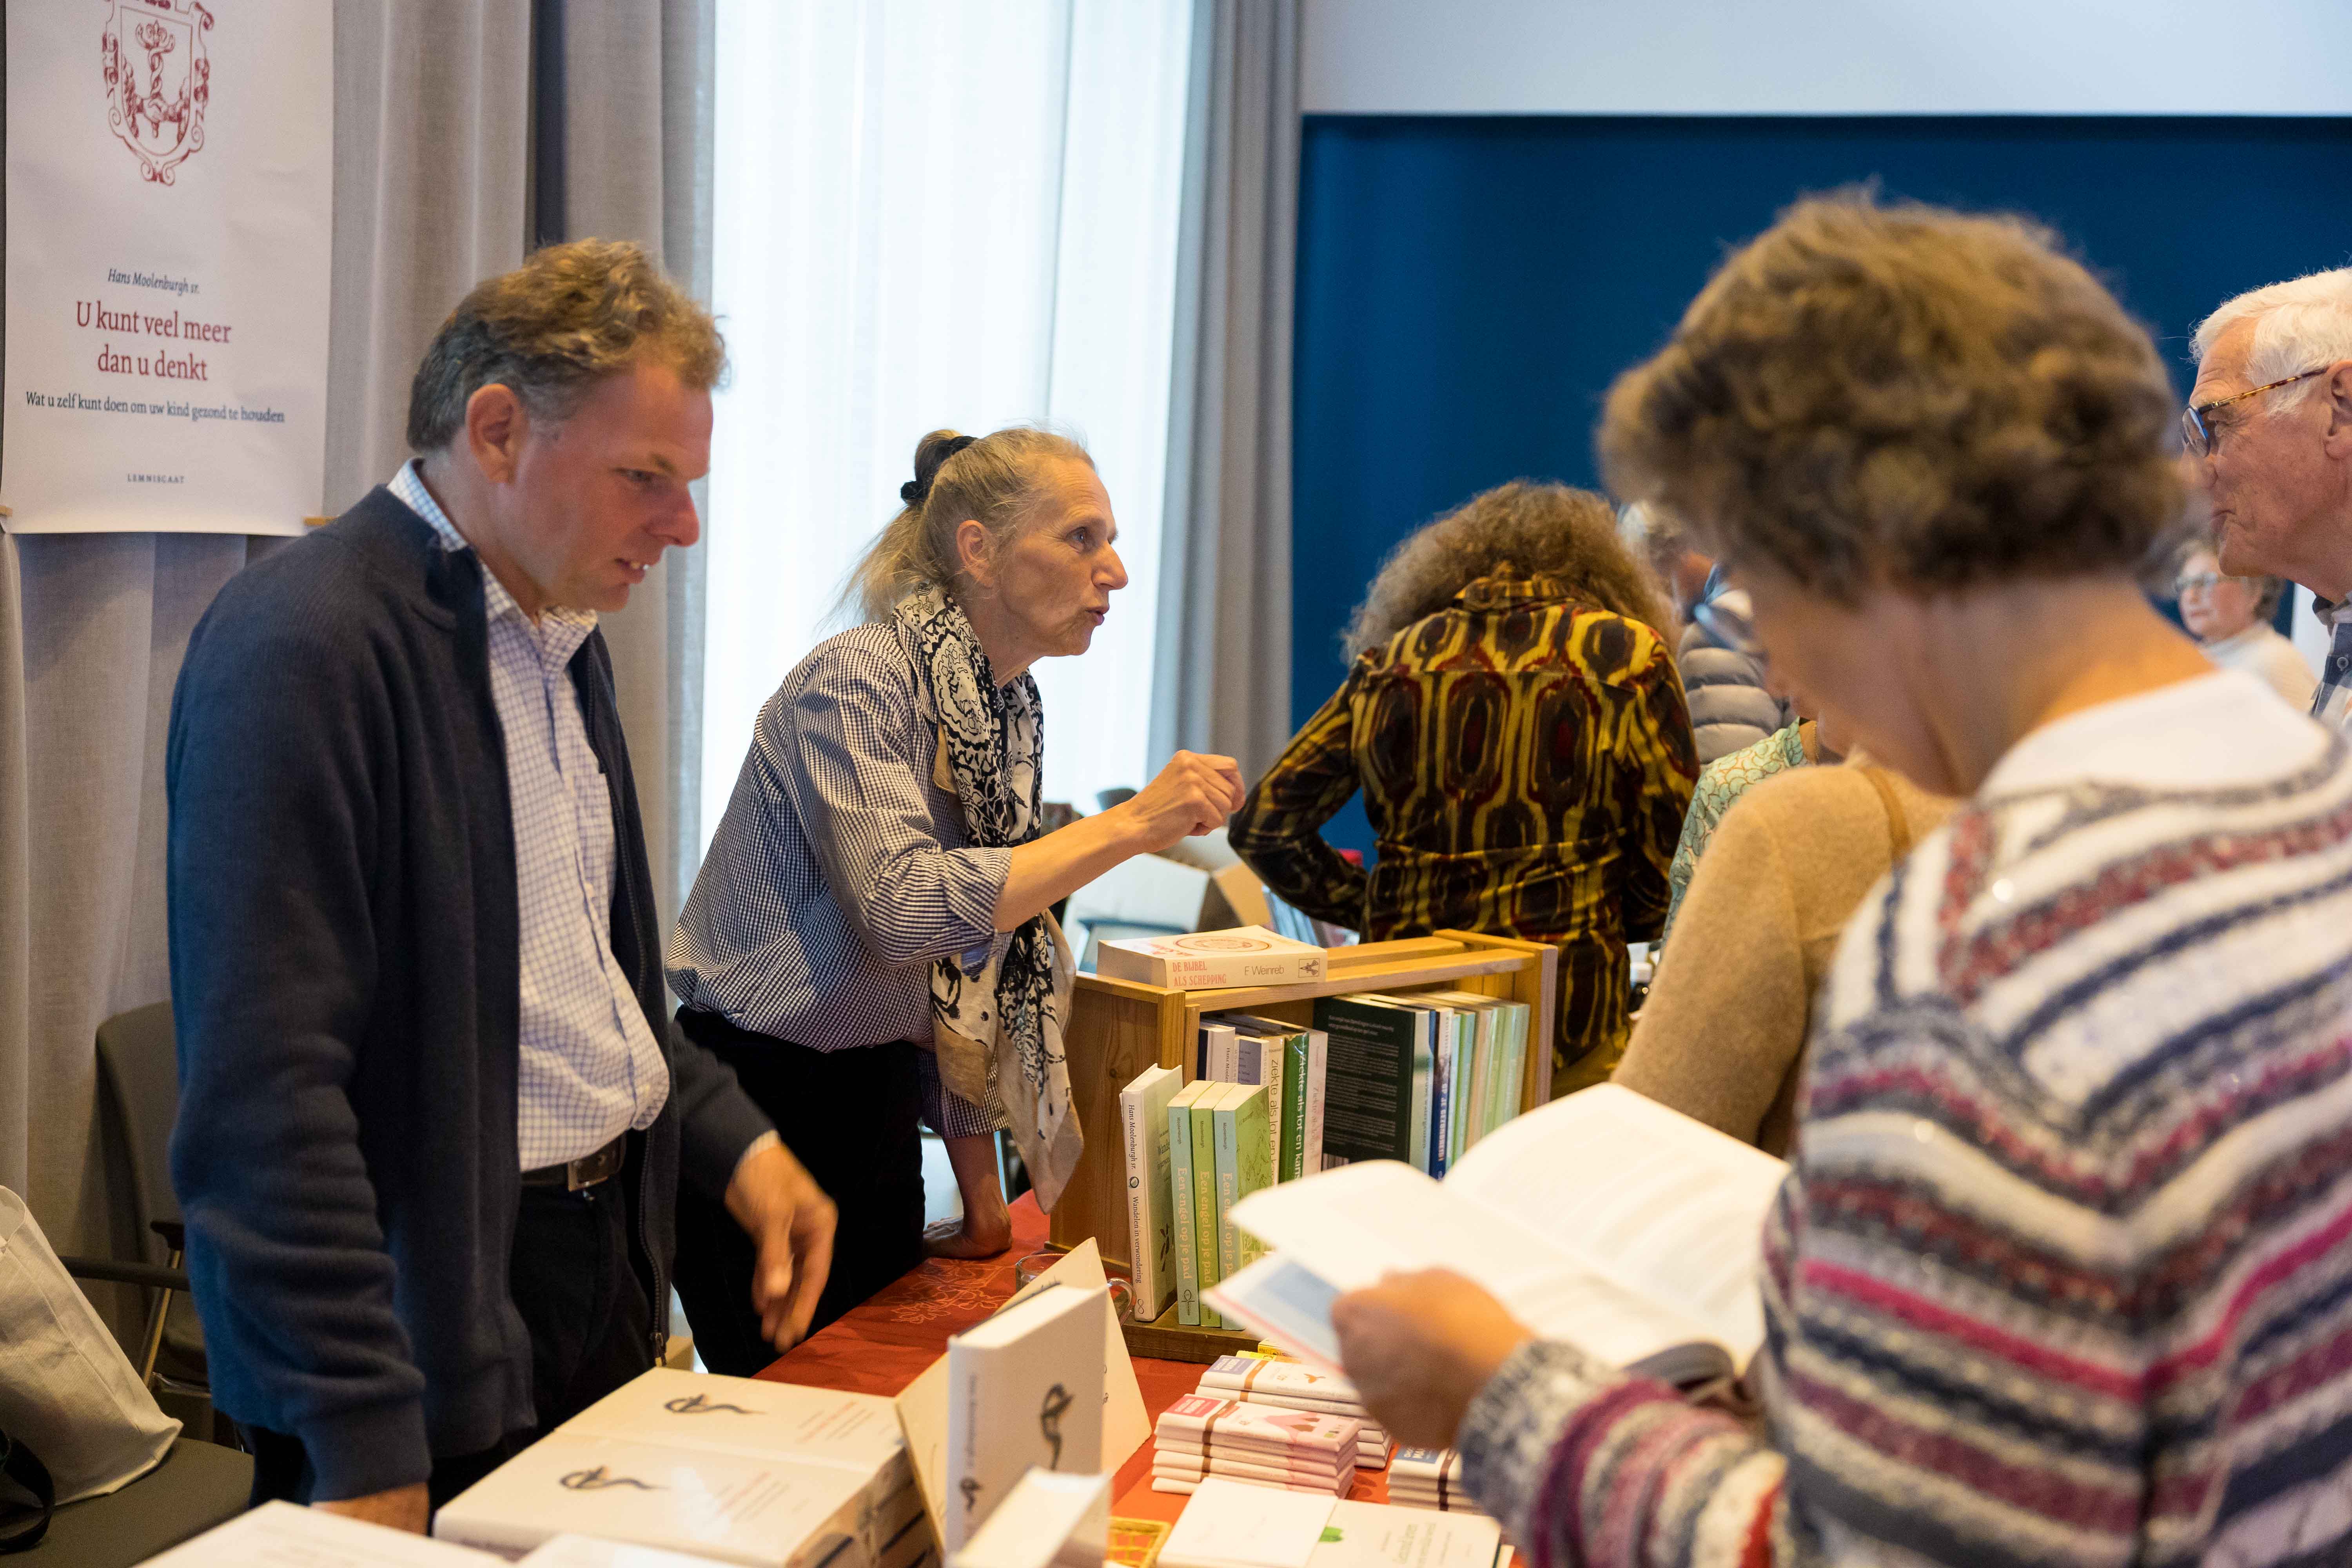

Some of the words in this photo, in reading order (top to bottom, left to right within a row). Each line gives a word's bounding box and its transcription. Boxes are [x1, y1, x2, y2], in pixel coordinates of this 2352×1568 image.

[108, 269, 130, 284] Hans
[132, 272, 189, 296] Moolenburgh
[76, 301, 91, 327] U
[96, 300, 139, 333] kunt
[144, 311, 178, 338] veel
[184, 320, 232, 343] meer
[98, 344, 132, 374] dan
[138, 357, 149, 376] u
[155, 350, 207, 381] denkt
[26, 392, 44, 407] Wat
[48, 396, 54, 407] u
[57, 393, 77, 408] zelf
[78, 394, 102, 411] kunt
[104, 396, 128, 413] doen
[131, 402, 146, 414] om
[149, 403, 163, 414] uw
[167, 400, 189, 416] kind
[192, 404, 226, 422] gezond
[229, 408, 238, 420] te
[241, 405, 284, 423] houden
[127, 473, 184, 483] LEMNISCAAT
[1172, 962, 1182, 972] DE
[1184, 961, 1207, 972] BIJBEL
[1252, 965, 1284, 975] Weinreb
[1174, 977, 1187, 987] ALS
[1189, 974, 1227, 985] SCHEPPING
[1129, 1122, 1137, 1163] Moolenburgh
[1296, 1135, 1301, 1150] en
[1178, 1167, 1187, 1191] Een
[1200, 1171, 1209, 1193] Een
[1223, 1172, 1232, 1196] Een
[1179, 1193, 1189, 1224] engel
[1200, 1198, 1212, 1230] engel
[1180, 1227, 1188, 1242] op
[1201, 1230, 1209, 1245] op
[1224, 1232, 1232, 1247] op
[1179, 1244, 1191, 1255] je
[1201, 1248, 1212, 1258] je
[1223, 1250, 1235, 1260] je
[1181, 1258, 1192, 1280] pad
[1203, 1261, 1214, 1283] pad
[1226, 1263, 1234, 1275] pa
